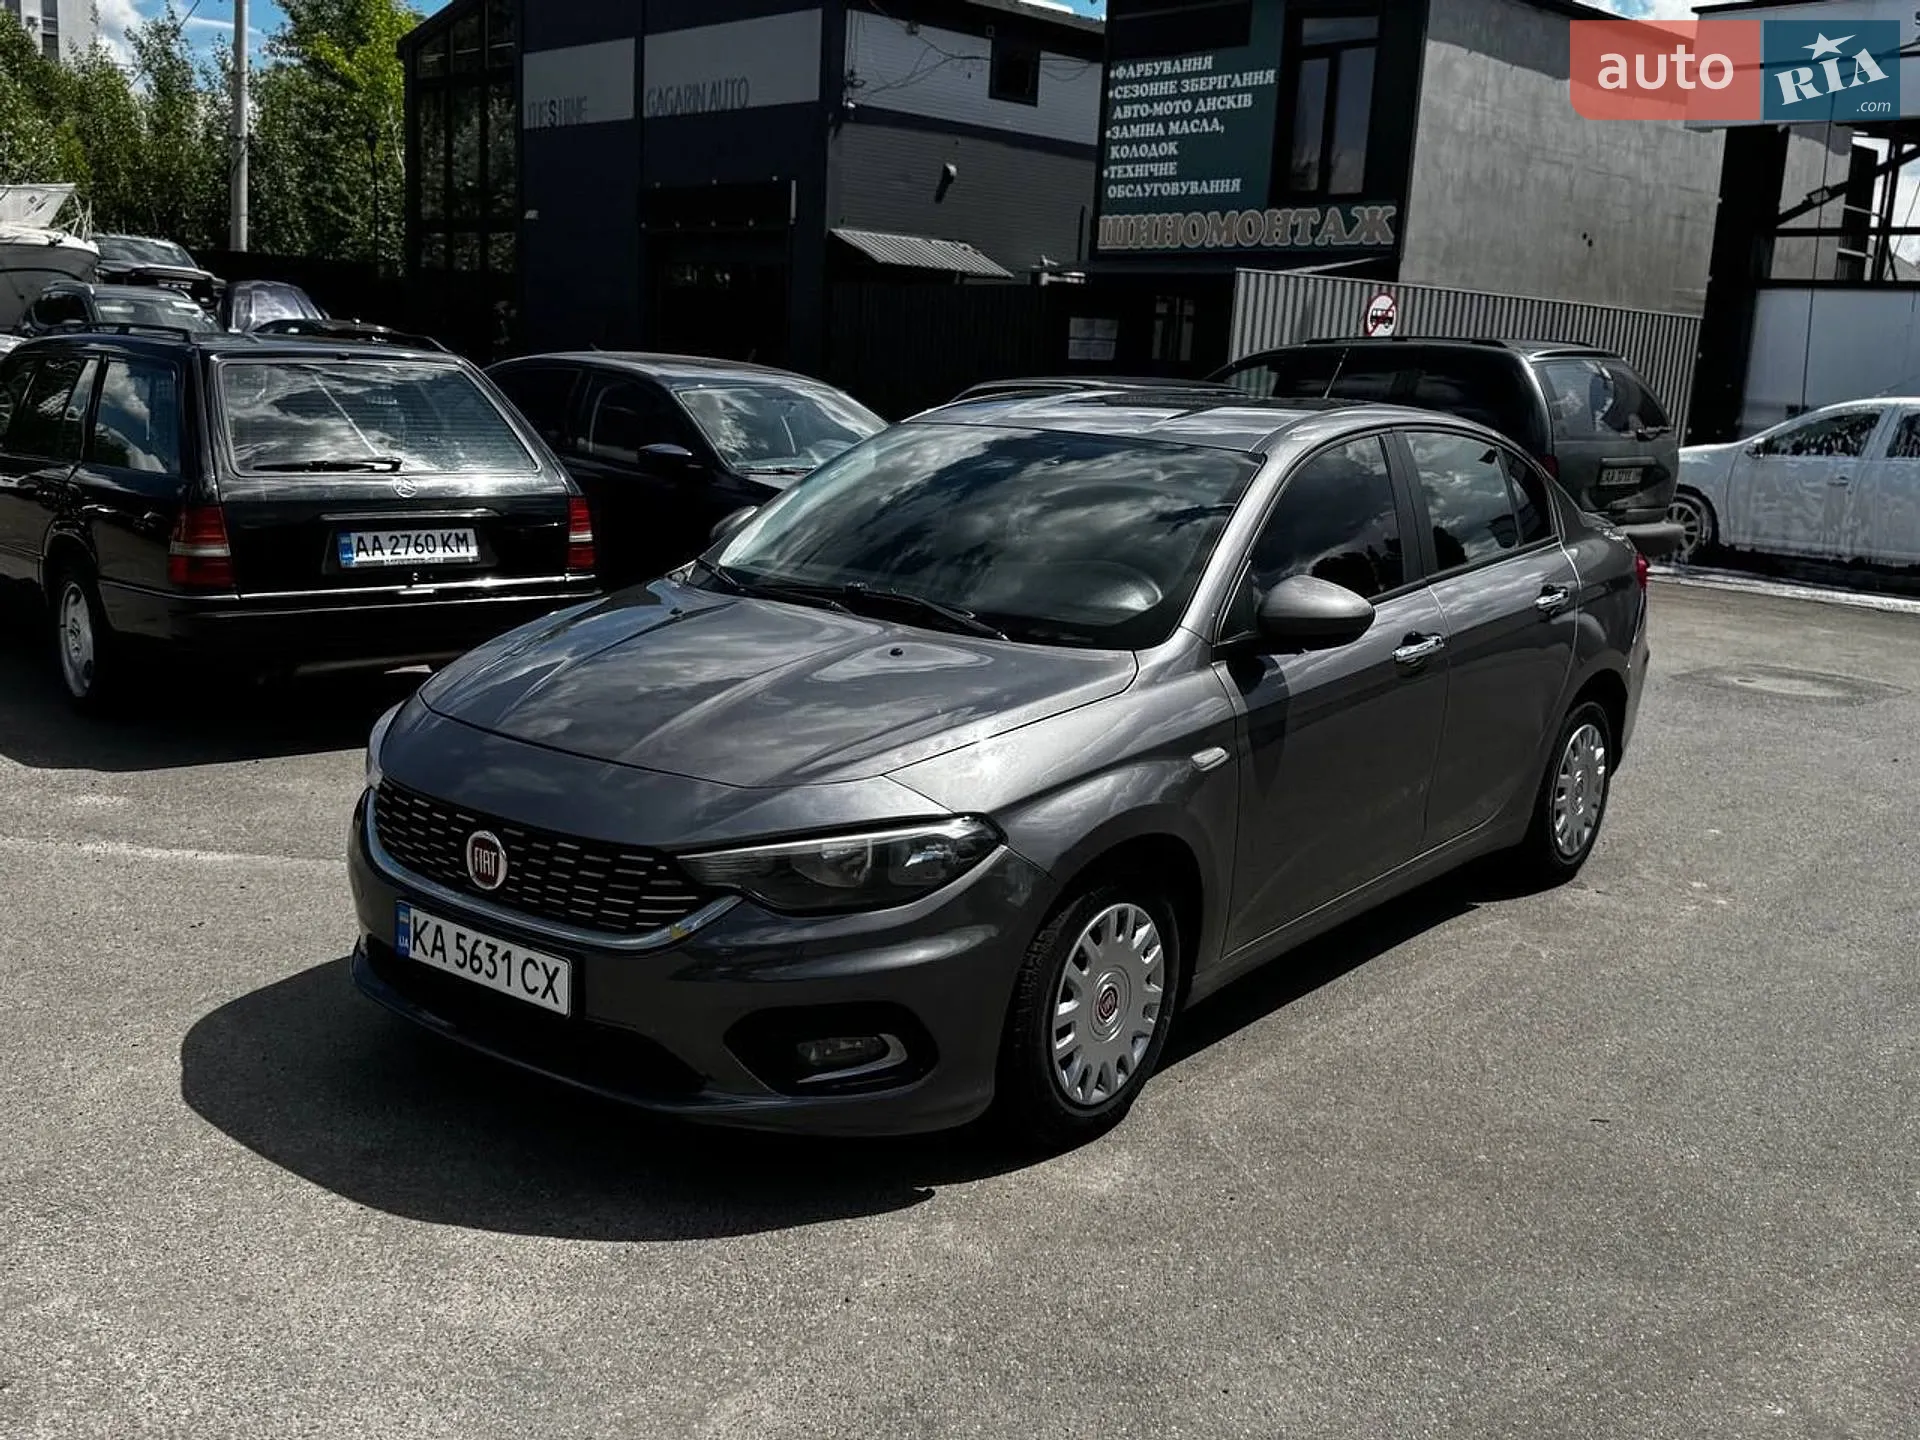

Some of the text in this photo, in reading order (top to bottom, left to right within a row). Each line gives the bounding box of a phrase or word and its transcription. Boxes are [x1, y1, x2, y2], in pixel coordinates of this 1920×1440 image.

[709, 76, 750, 111] AUTO
[1179, 69, 1277, 93] ЗБЕРІГАННЯ
[1112, 93, 1253, 120] АВТО-МОТО ДИСКІВ
[1168, 117, 1225, 135] МАСЛА,
[1109, 141, 1180, 160] КОЛОДОК
[1107, 178, 1243, 199] ОБСЛУГОВУВАННЯ
[1097, 205, 1398, 249] ШИНОМОНТАЖ
[355, 533, 470, 557] AA 2760 KM
[474, 847, 498, 878] FIAT
[412, 917, 560, 1004] KA 5631 CX
